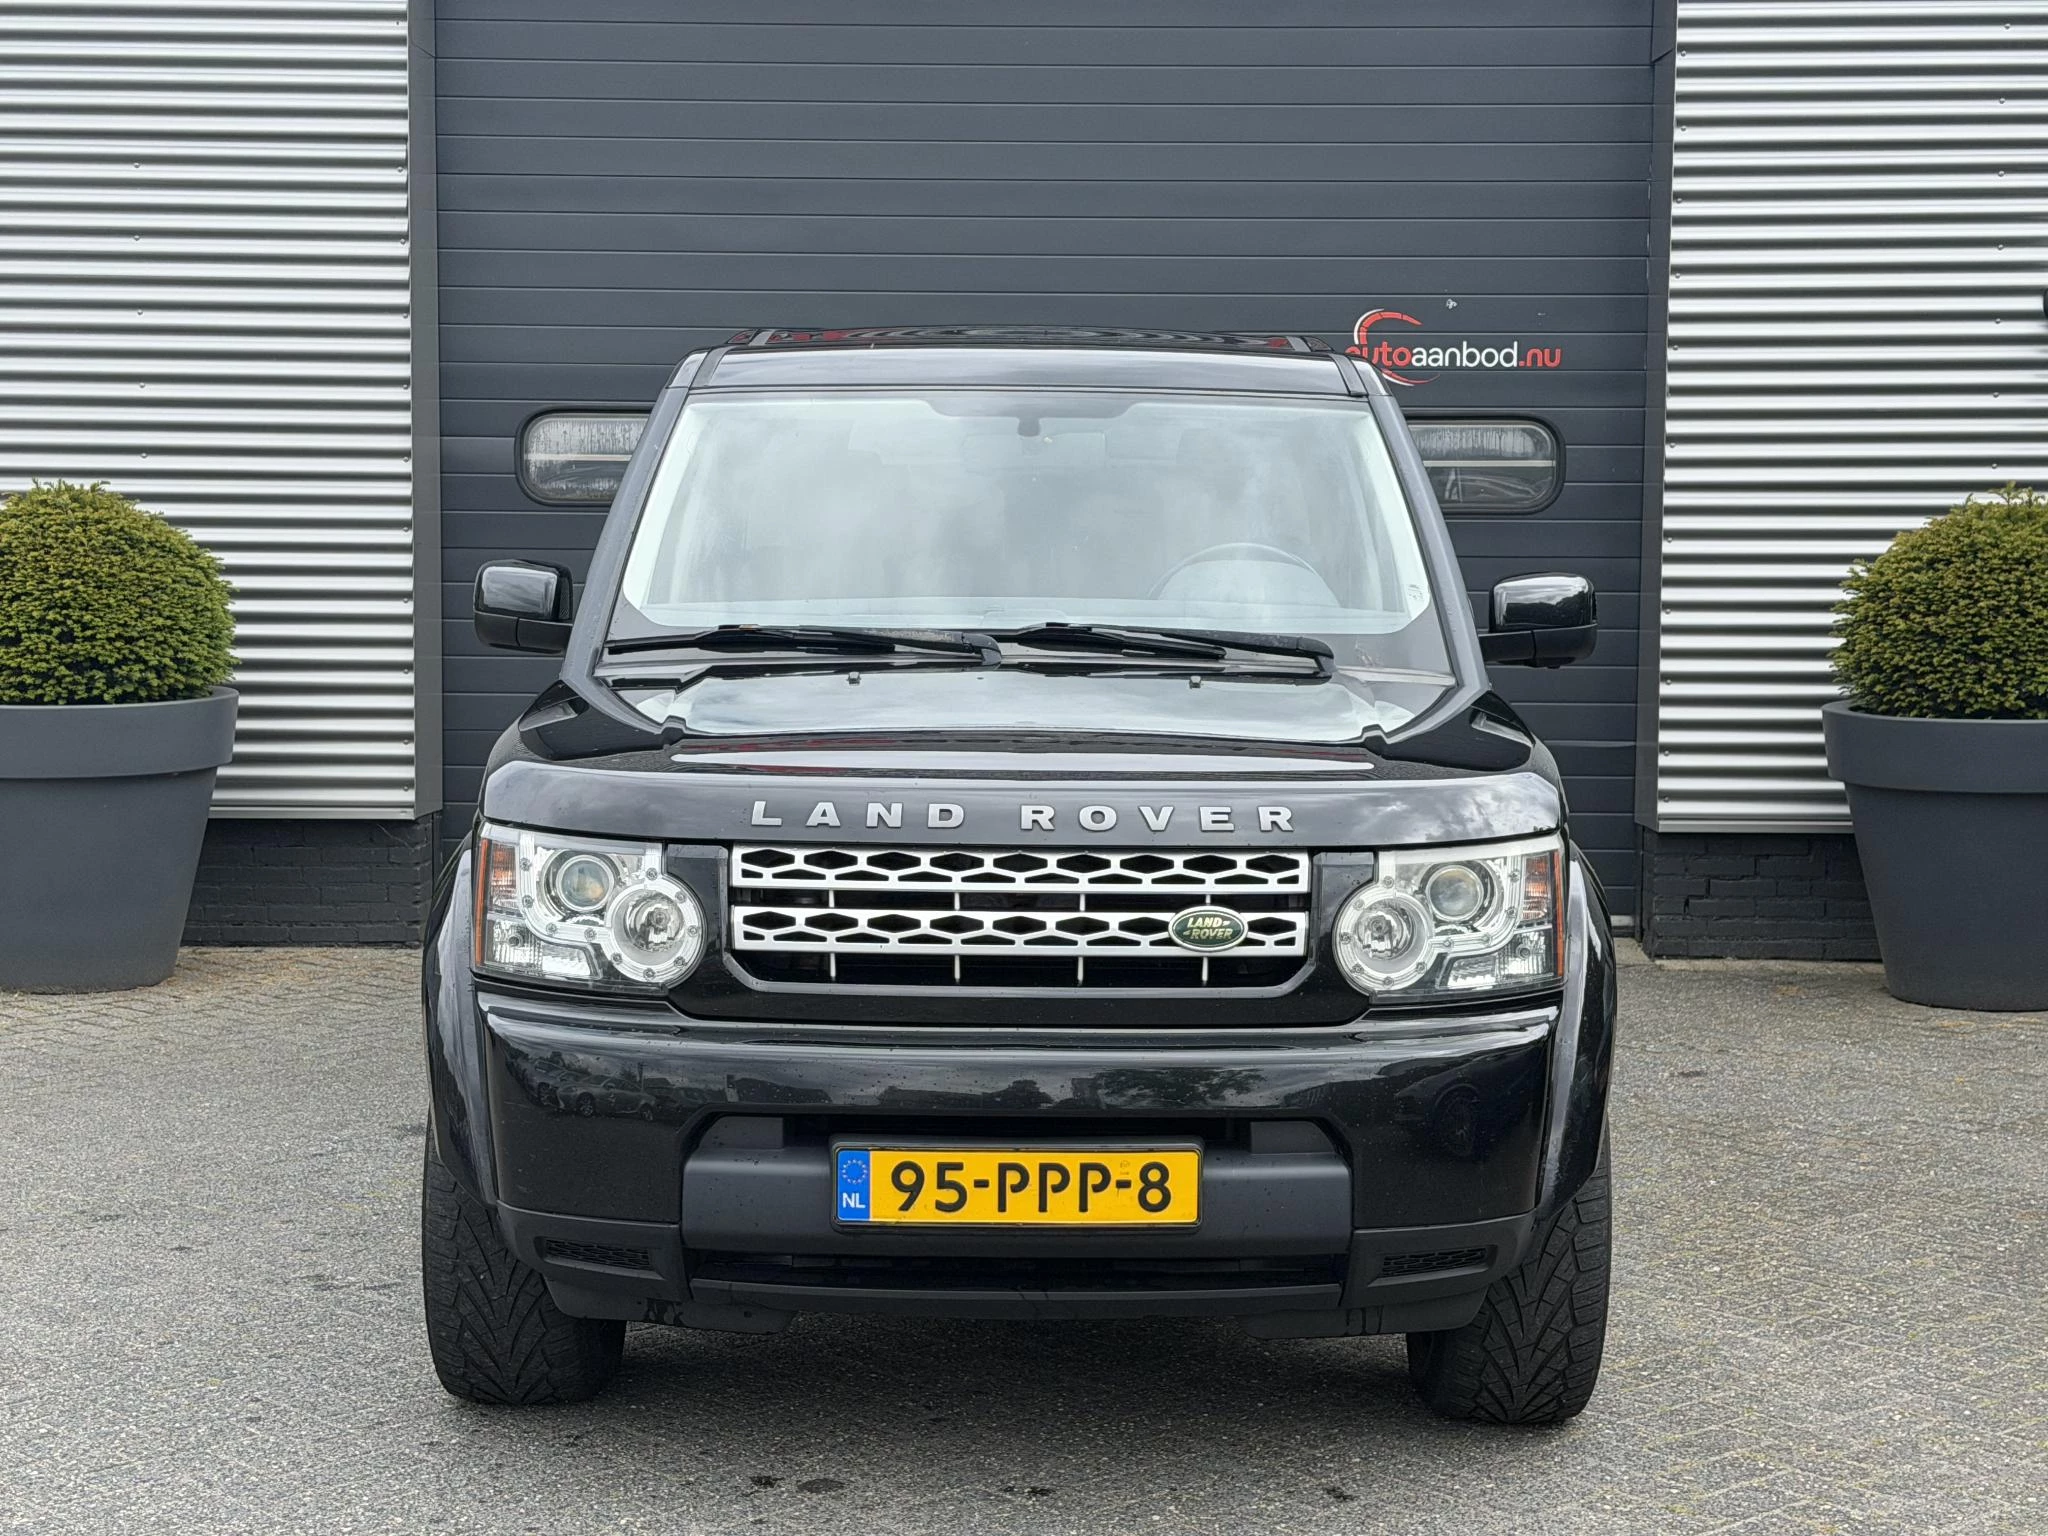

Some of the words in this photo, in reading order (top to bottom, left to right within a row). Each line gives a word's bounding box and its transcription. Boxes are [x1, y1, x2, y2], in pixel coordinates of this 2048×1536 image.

[750, 800, 965, 829] LAND
[1020, 802, 1295, 832] ROVER
[1187, 917, 1223, 928] LAND
[1190, 928, 1234, 940] ROVER
[890, 1160, 1172, 1214] 95-PPP-8
[842, 1192, 866, 1209] NL
